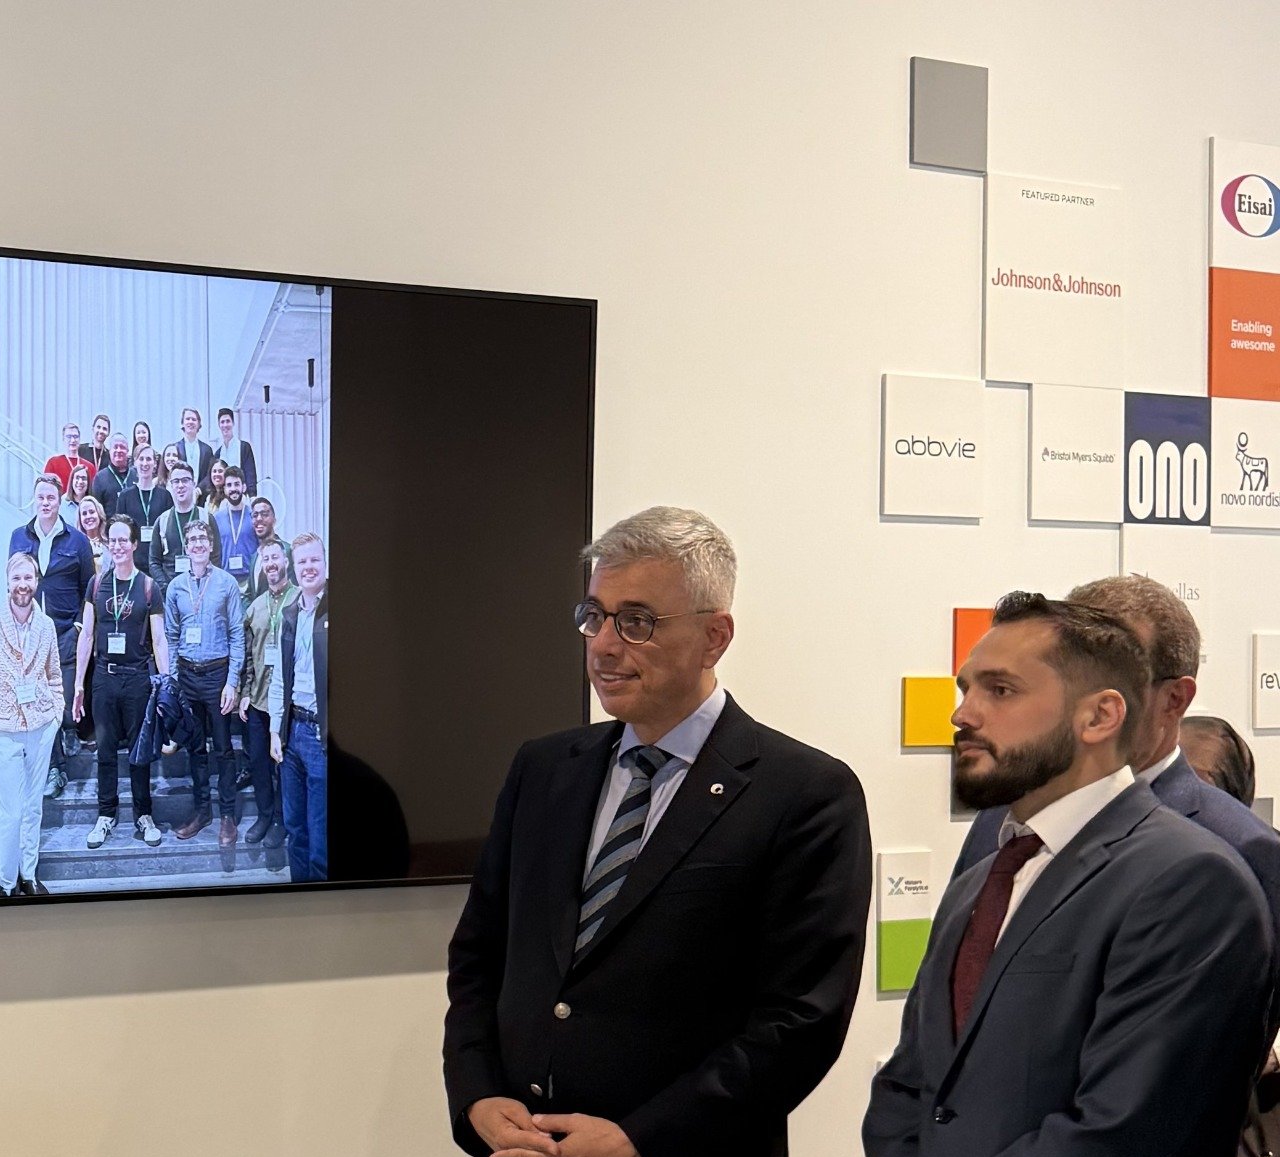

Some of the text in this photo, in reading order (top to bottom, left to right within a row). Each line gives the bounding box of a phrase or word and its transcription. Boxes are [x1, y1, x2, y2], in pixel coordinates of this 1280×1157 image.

[1021, 189, 1095, 207] FEATURED PARTNER
[1237, 193, 1273, 217] Eisai
[991, 267, 1122, 298] Johnson&Johnson
[1231, 319, 1273, 337] Enabling
[1230, 338, 1276, 352] awesome
[895, 434, 976, 459] abbvie
[1050, 450, 1071, 461] Bristol
[1072, 451, 1092, 463] Myers
[1220, 492, 1280, 507] novo nordis
